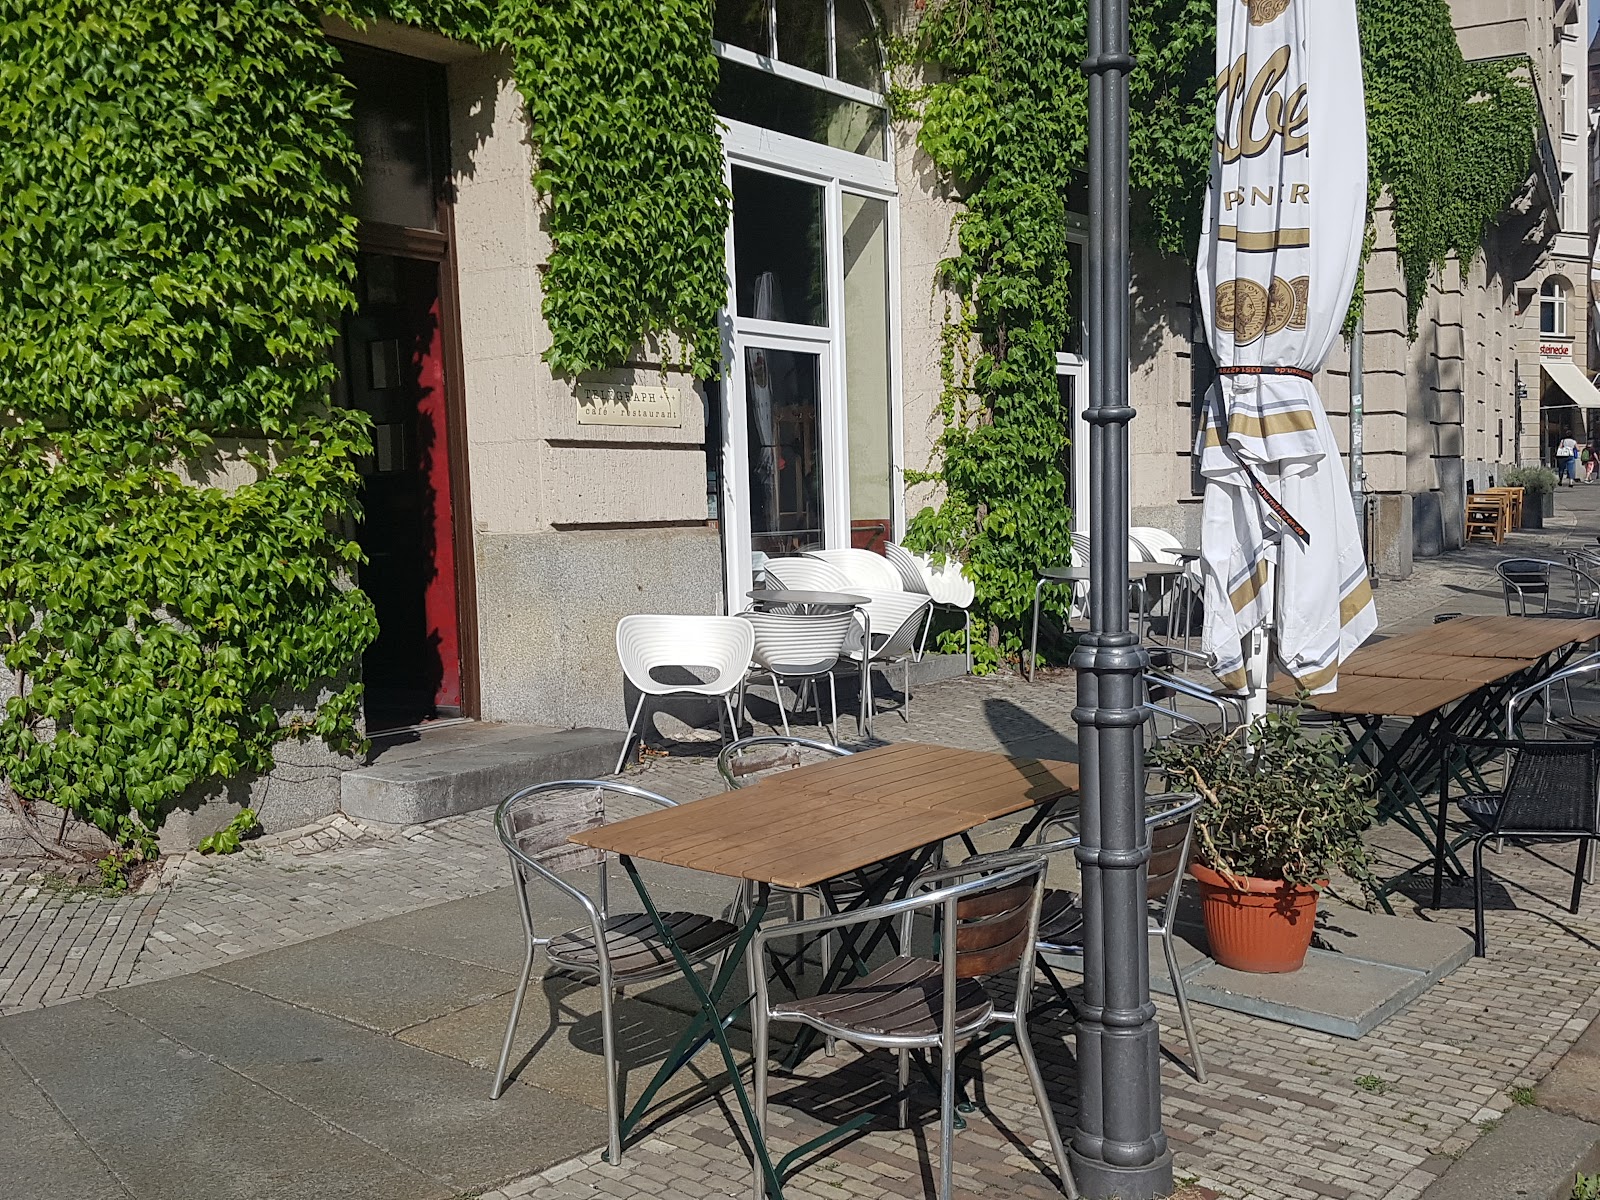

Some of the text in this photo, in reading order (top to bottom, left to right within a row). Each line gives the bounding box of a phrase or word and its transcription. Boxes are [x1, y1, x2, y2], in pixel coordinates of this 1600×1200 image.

[1244, 283, 1260, 295] VON
[1540, 344, 1569, 355] steinecke
[584, 389, 656, 402] TELEGRAPH
[585, 407, 677, 419] café restaurant
[1255, 482, 1304, 536] schirmfritzen.de
